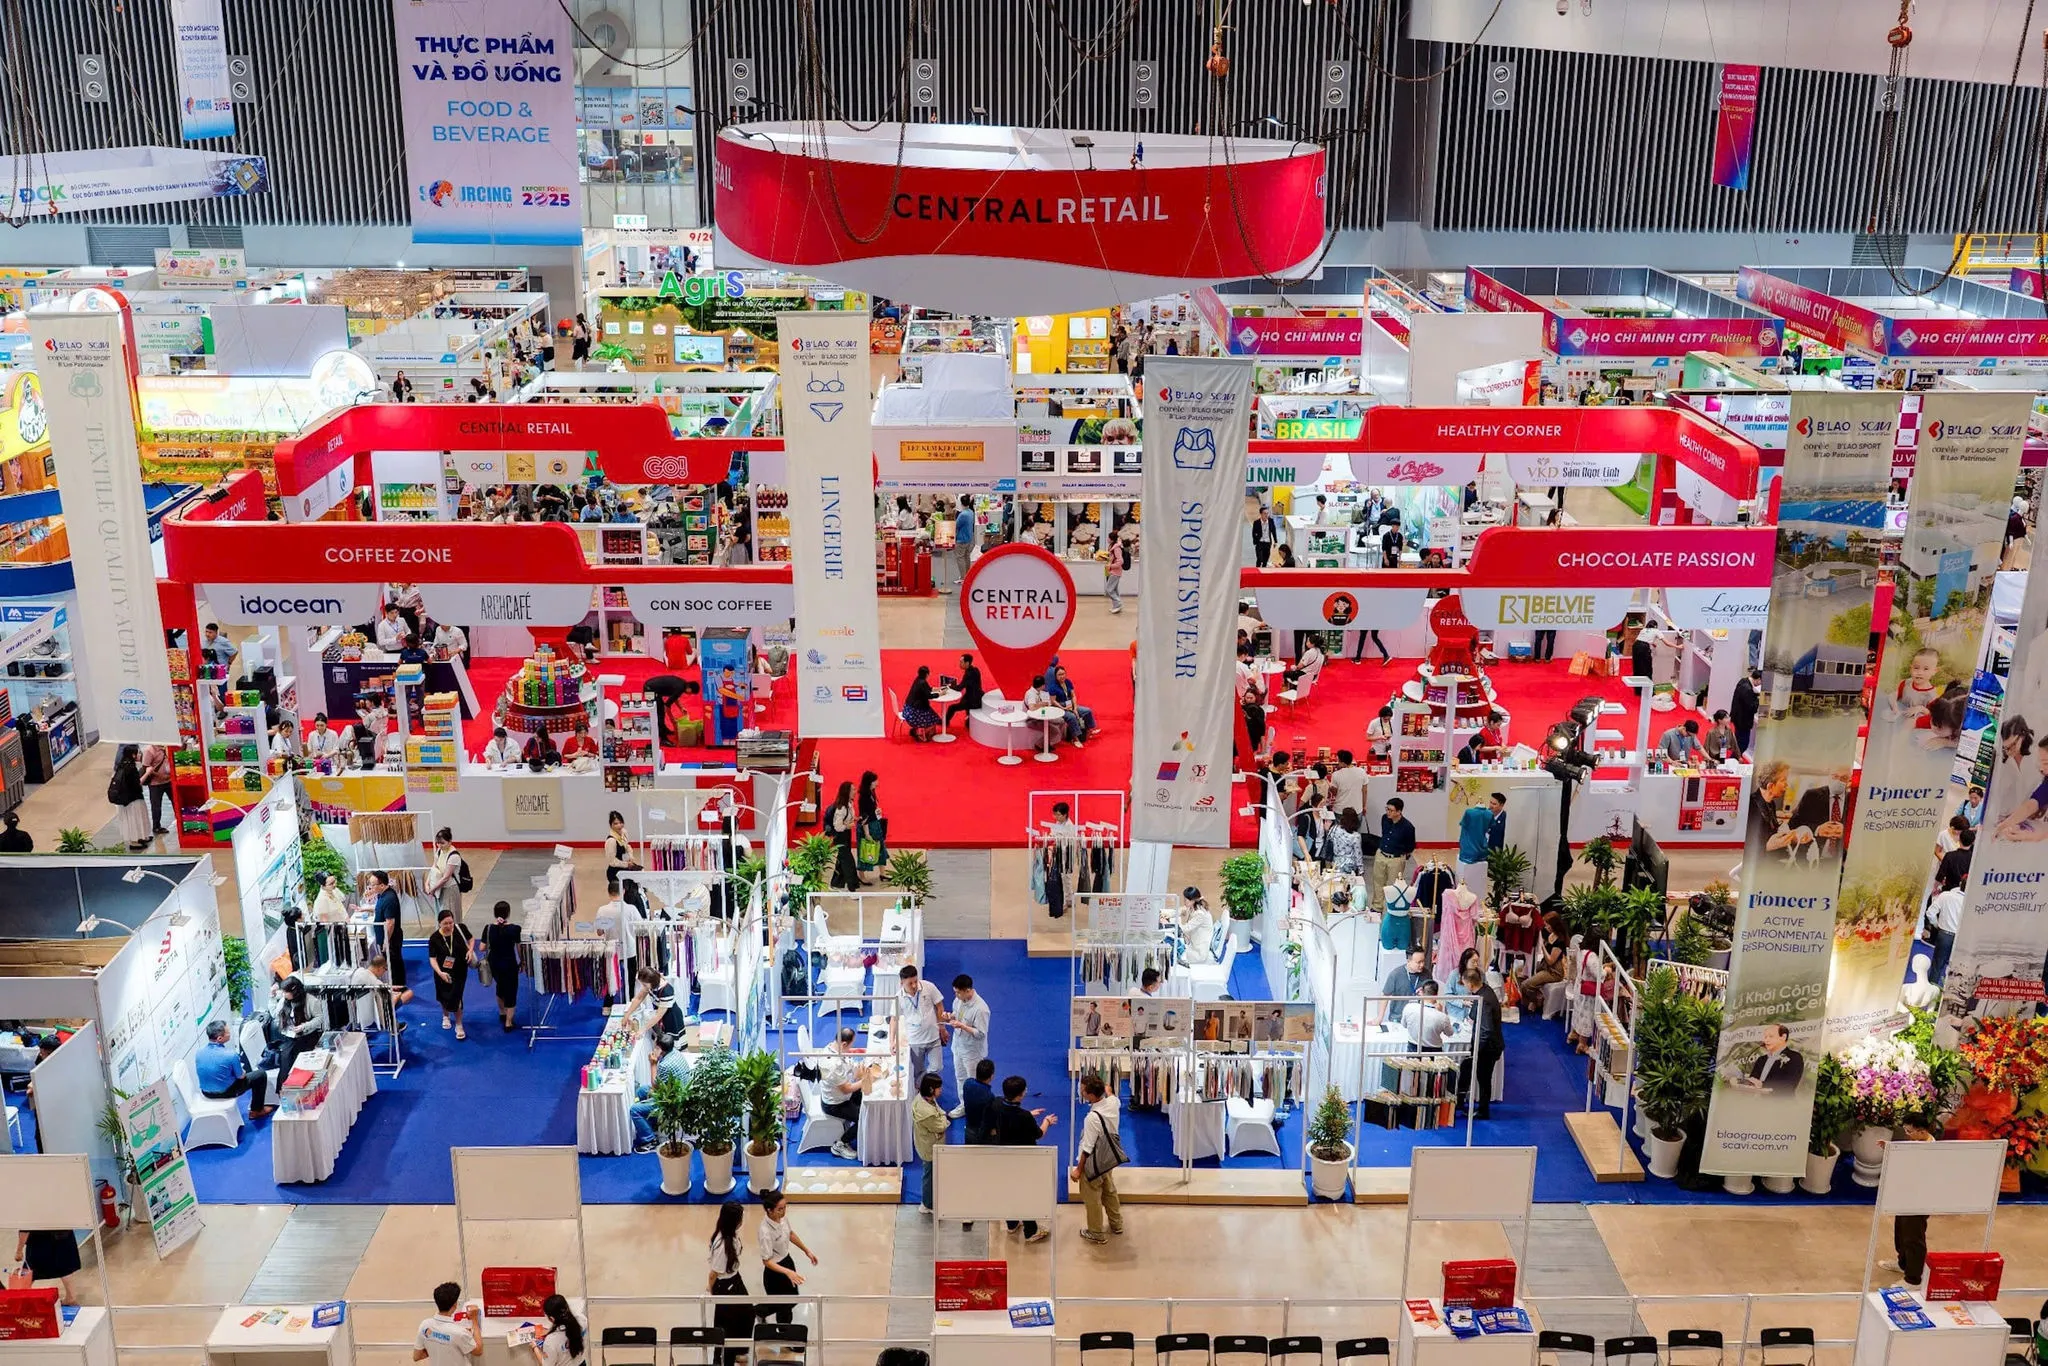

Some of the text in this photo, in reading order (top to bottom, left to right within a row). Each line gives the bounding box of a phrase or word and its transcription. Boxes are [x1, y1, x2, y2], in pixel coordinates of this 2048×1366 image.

[415, 32, 554, 58] THỰC PHẨM
[412, 59, 562, 83] VÀ ĐỒ UỐNG
[448, 101, 532, 118] FOOD &
[432, 126, 551, 143] BEVERAGE
[522, 192, 570, 207] 2025
[617, 216, 646, 225] EXIT
[658, 271, 745, 306] AgriS
[1762, 285, 1773, 301] HO
[1775, 289, 1788, 307] CHI
[1789, 294, 1812, 316] MINH
[1812, 302, 1832, 323] CITY
[1832, 309, 1863, 335] Pavilion
[1261, 331, 1280, 342] HO
[1284, 331, 1308, 342] CHI
[1310, 331, 1346, 342] MINH
[1590, 332, 1752, 344] HO CHI MINH CITY Pavilion
[1920, 334, 1940, 343] HO
[1943, 333, 1966, 344] CHI
[1968, 333, 2003, 344] MINH
[2007, 333, 2035, 344] CITY
[1175, 391, 1236, 401] B'LAO SCAVI
[460, 422, 572, 434] CENTRAL RETAIL
[1276, 420, 1351, 439] BRASIL
[1438, 425, 1562, 437] HEALTHY CORNER
[1816, 421, 1892, 431] B'LAO SCAVI
[1947, 425, 2022, 435] B'LAO SCAVI
[327, 435, 344, 453] RETAIL
[1679, 434, 1726, 472] HEALTHY CORNER
[86, 422, 115, 513] TEXTILE
[643, 456, 688, 479] GO!
[1257, 467, 1296, 483] NINH
[1527, 466, 1559, 478] VKD
[1602, 466, 1620, 477] Linh
[230, 497, 248, 521] ZONE
[820, 476, 843, 580] LINGERIE
[325, 548, 452, 563] COFFEE ZONE
[1557, 552, 1756, 567] CHOCOLATE PASSION
[98, 519, 130, 612] QUALITY
[971, 588, 1066, 603] CENTRAL
[1175, 501, 1204, 680] SPORTSWEAR
[240, 595, 343, 614] idocean
[650, 600, 772, 611] CON SOC COFFEE
[1531, 595, 1595, 614] BELVIE
[986, 605, 1055, 620] RETAIL
[1530, 615, 1594, 624] CHOCOLATE
[1936, 788, 1944, 799] 2
[1900, 808, 1938, 817] SOCIAL
[1821, 897, 1831, 911] 3
[1985, 892, 2038, 902] INDUSTRY
[1764, 917, 1805, 927] ACTIVE
[1746, 983, 1822, 1004] Khởi Công
[1717, 1129, 1797, 1143] blaogroup.com
[1721, 1140, 1789, 1151] scavi.com.vn
